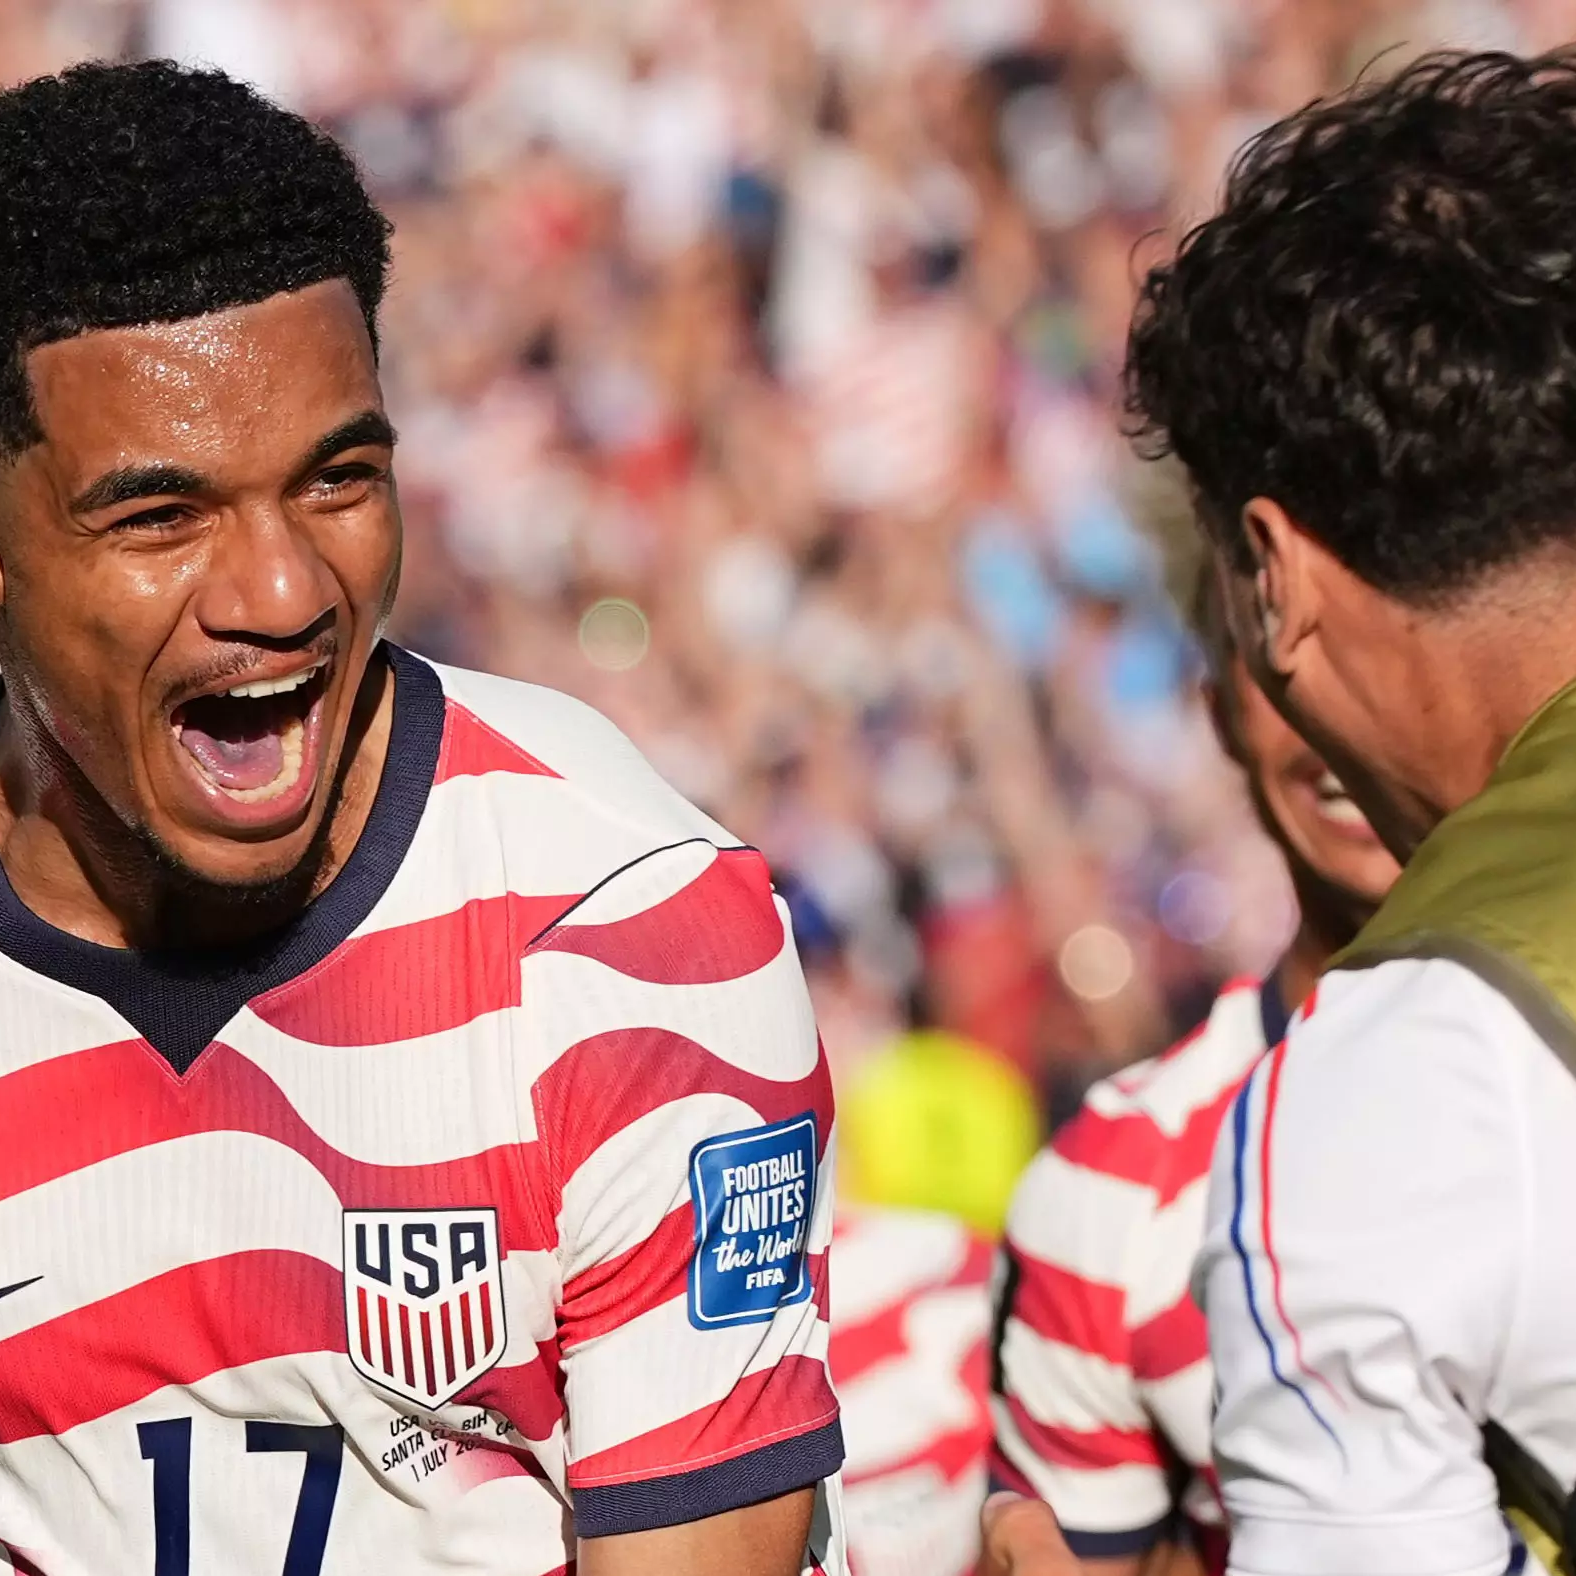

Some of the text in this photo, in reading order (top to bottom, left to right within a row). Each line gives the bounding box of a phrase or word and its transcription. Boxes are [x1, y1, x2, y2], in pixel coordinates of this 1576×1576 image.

[722, 1149, 806, 1196] FOOTBALL
[721, 1179, 806, 1235] UNITES
[355, 1221, 487, 1299] USA
[712, 1237, 755, 1273] the
[745, 1267, 786, 1290] FIFA
[390, 1414, 421, 1437] USA
[461, 1409, 488, 1431] BIH
[381, 1431, 425, 1472] SANTA
[411, 1464, 421, 1483] 1
[421, 1443, 449, 1477] JULY
